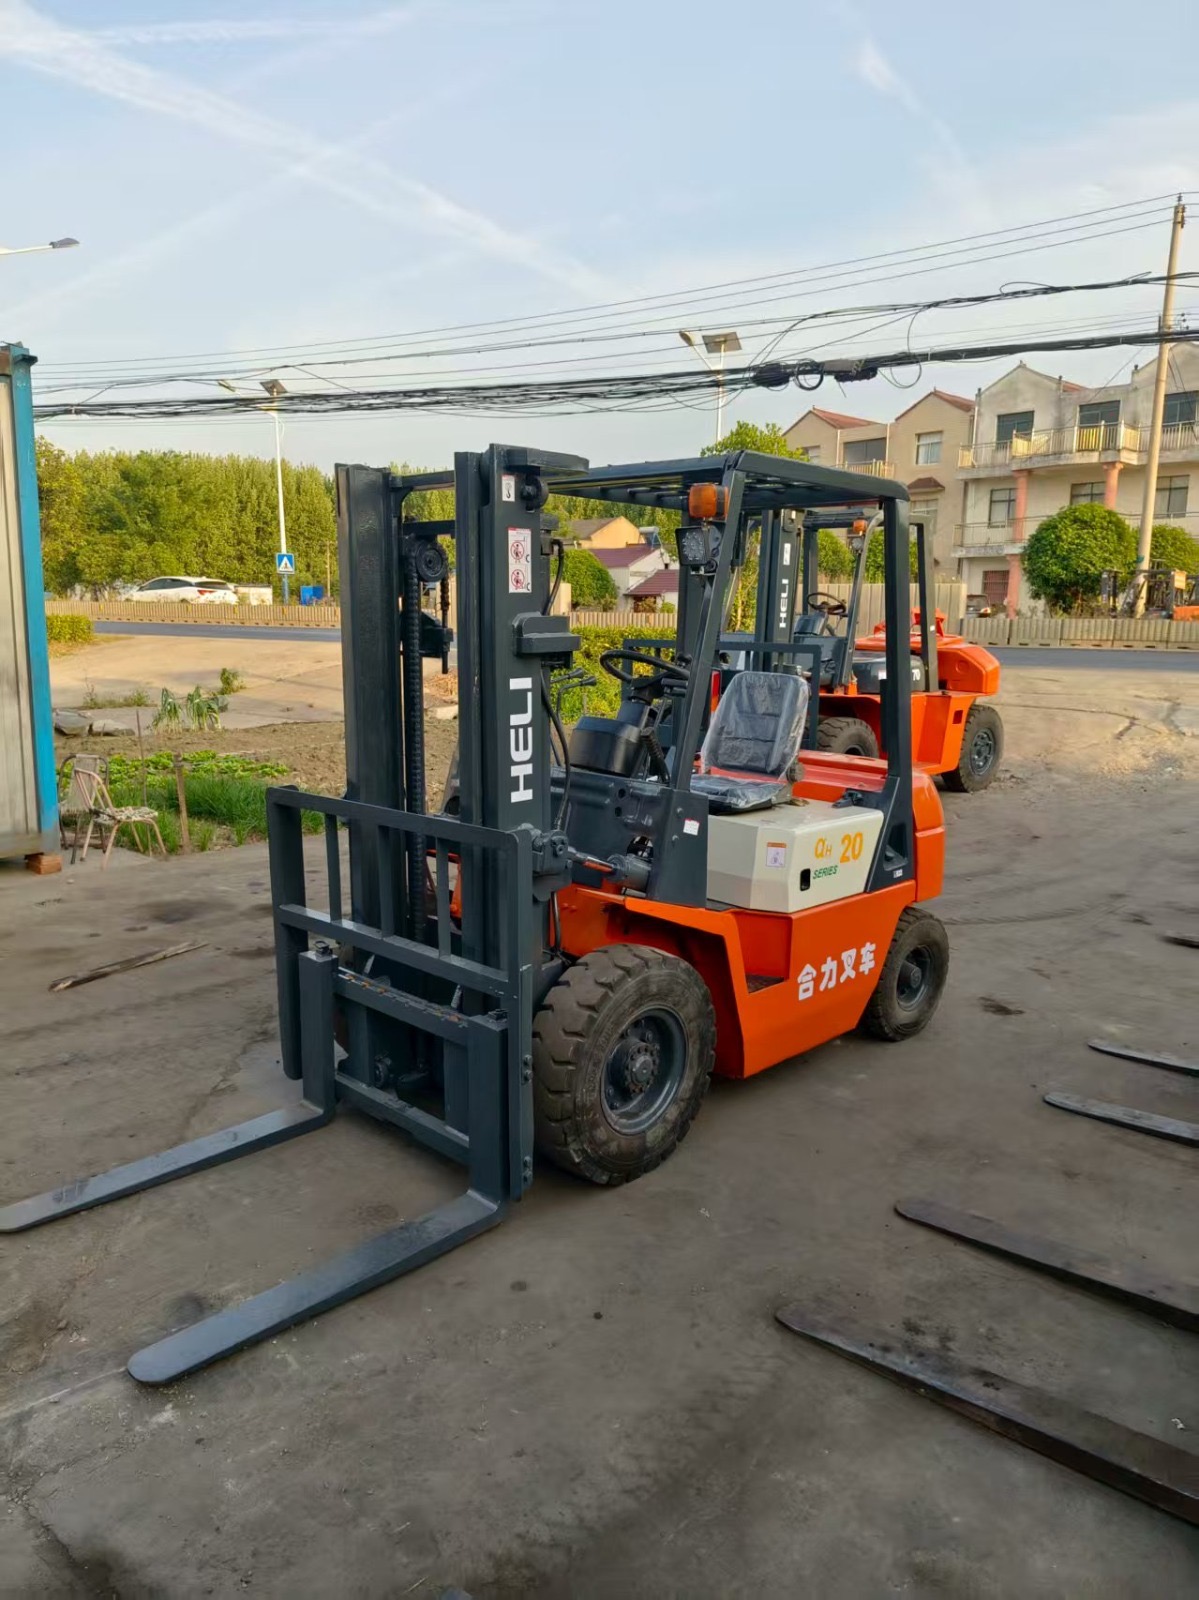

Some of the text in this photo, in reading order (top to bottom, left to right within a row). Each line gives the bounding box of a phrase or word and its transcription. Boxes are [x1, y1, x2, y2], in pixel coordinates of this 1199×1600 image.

[779, 579, 789, 628] HELI
[510, 677, 533, 803] HELI
[813, 865, 838, 879] SERIES
[839, 832, 863, 863] 20
[797, 941, 876, 1001] 合力叉车
